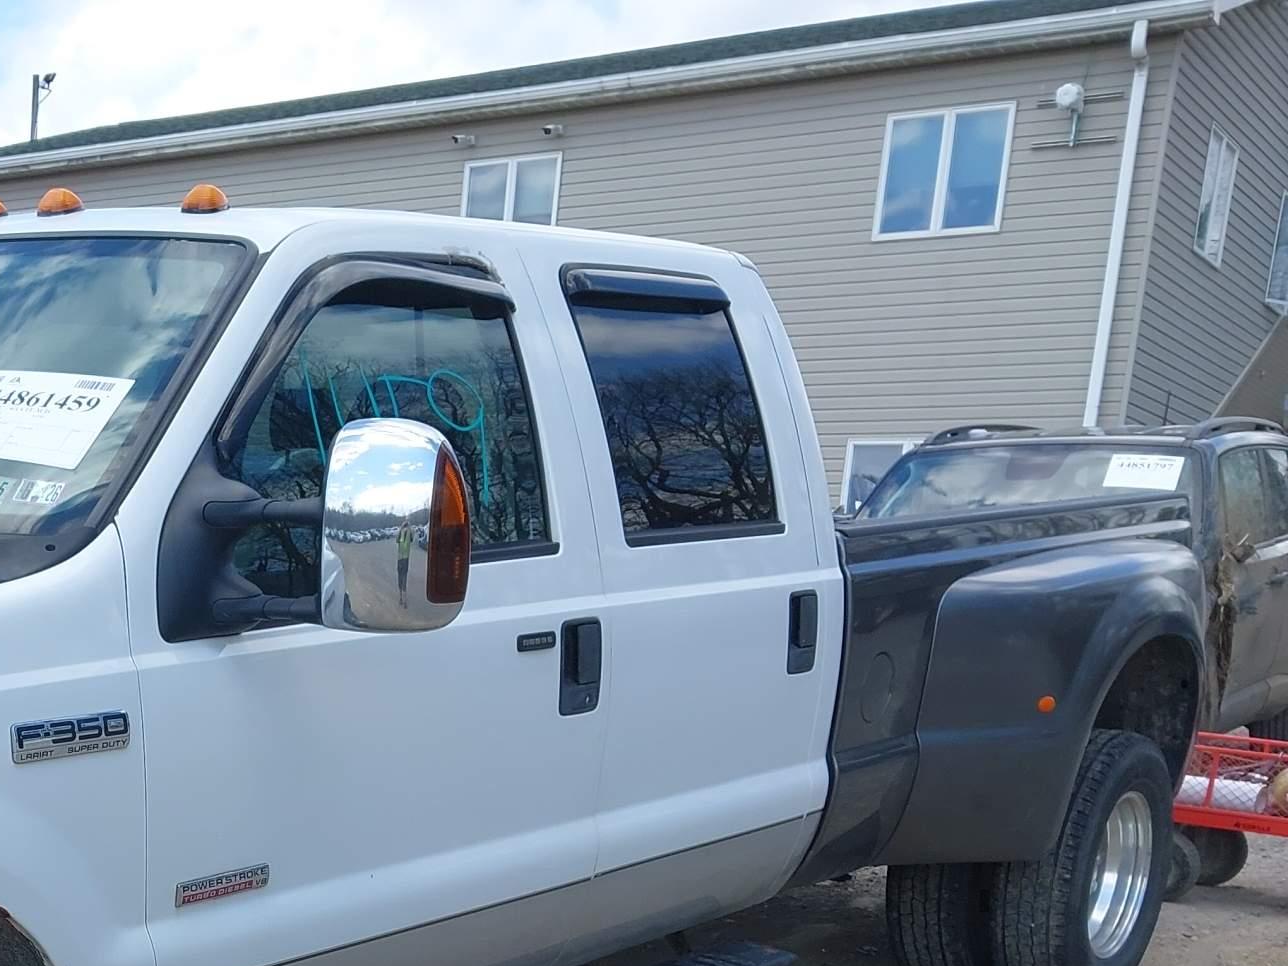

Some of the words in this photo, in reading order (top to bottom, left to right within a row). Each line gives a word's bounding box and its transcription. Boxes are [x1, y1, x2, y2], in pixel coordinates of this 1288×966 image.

[16, 712, 129, 749] F-350
[20, 749, 54, 761] LARIAT
[67, 743, 99, 754] SUPER
[101, 739, 127, 749] DUTY
